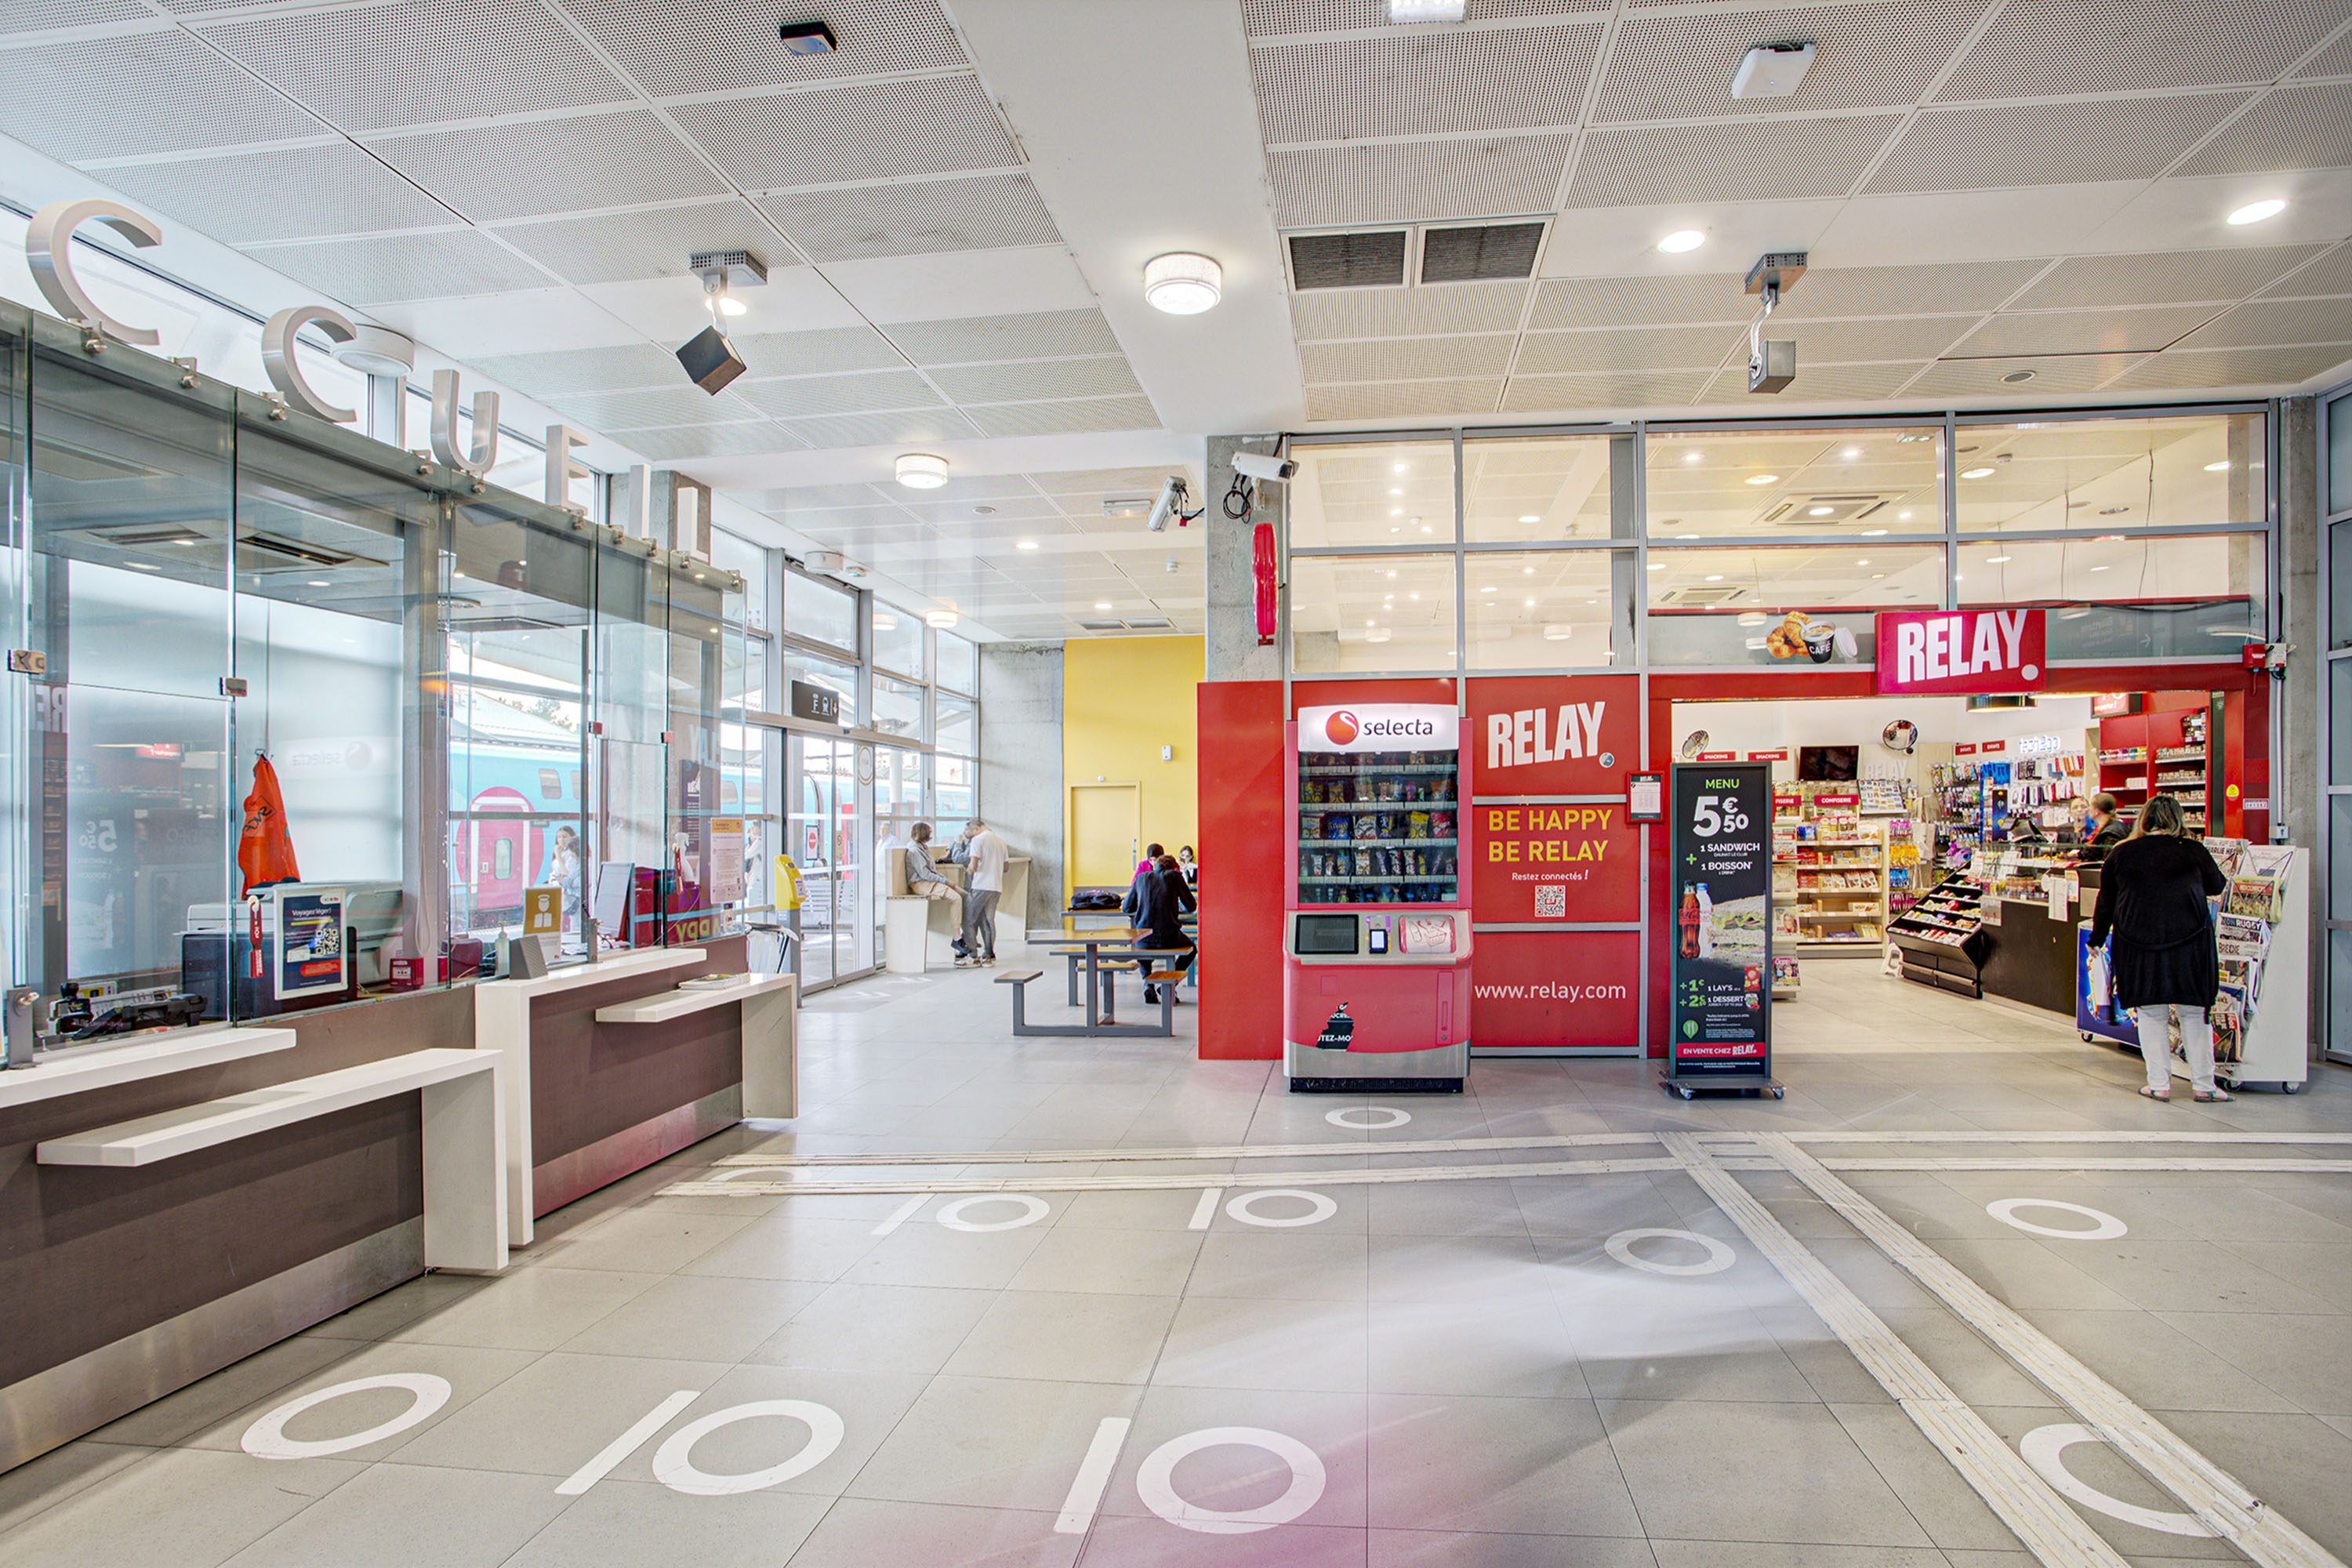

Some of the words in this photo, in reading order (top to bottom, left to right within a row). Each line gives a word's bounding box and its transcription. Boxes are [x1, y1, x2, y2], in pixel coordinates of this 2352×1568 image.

[26, 199, 709, 561] CCUEIL
[1809, 641, 1831, 654] CAFÉ
[1363, 719, 1432, 735] selecta
[1705, 779, 1740, 789] MENU
[1489, 810, 1520, 831] BE
[1529, 809, 1612, 831] HAPPY
[1489, 841, 1520, 862] BE
[1529, 840, 1608, 862] RELAY
[1707, 843, 1761, 852] SANDWICH
[1541, 871, 1582, 880] connectés
[2237, 920, 2263, 931] RUGBY
[1475, 981, 1626, 1003] www.relay.com
